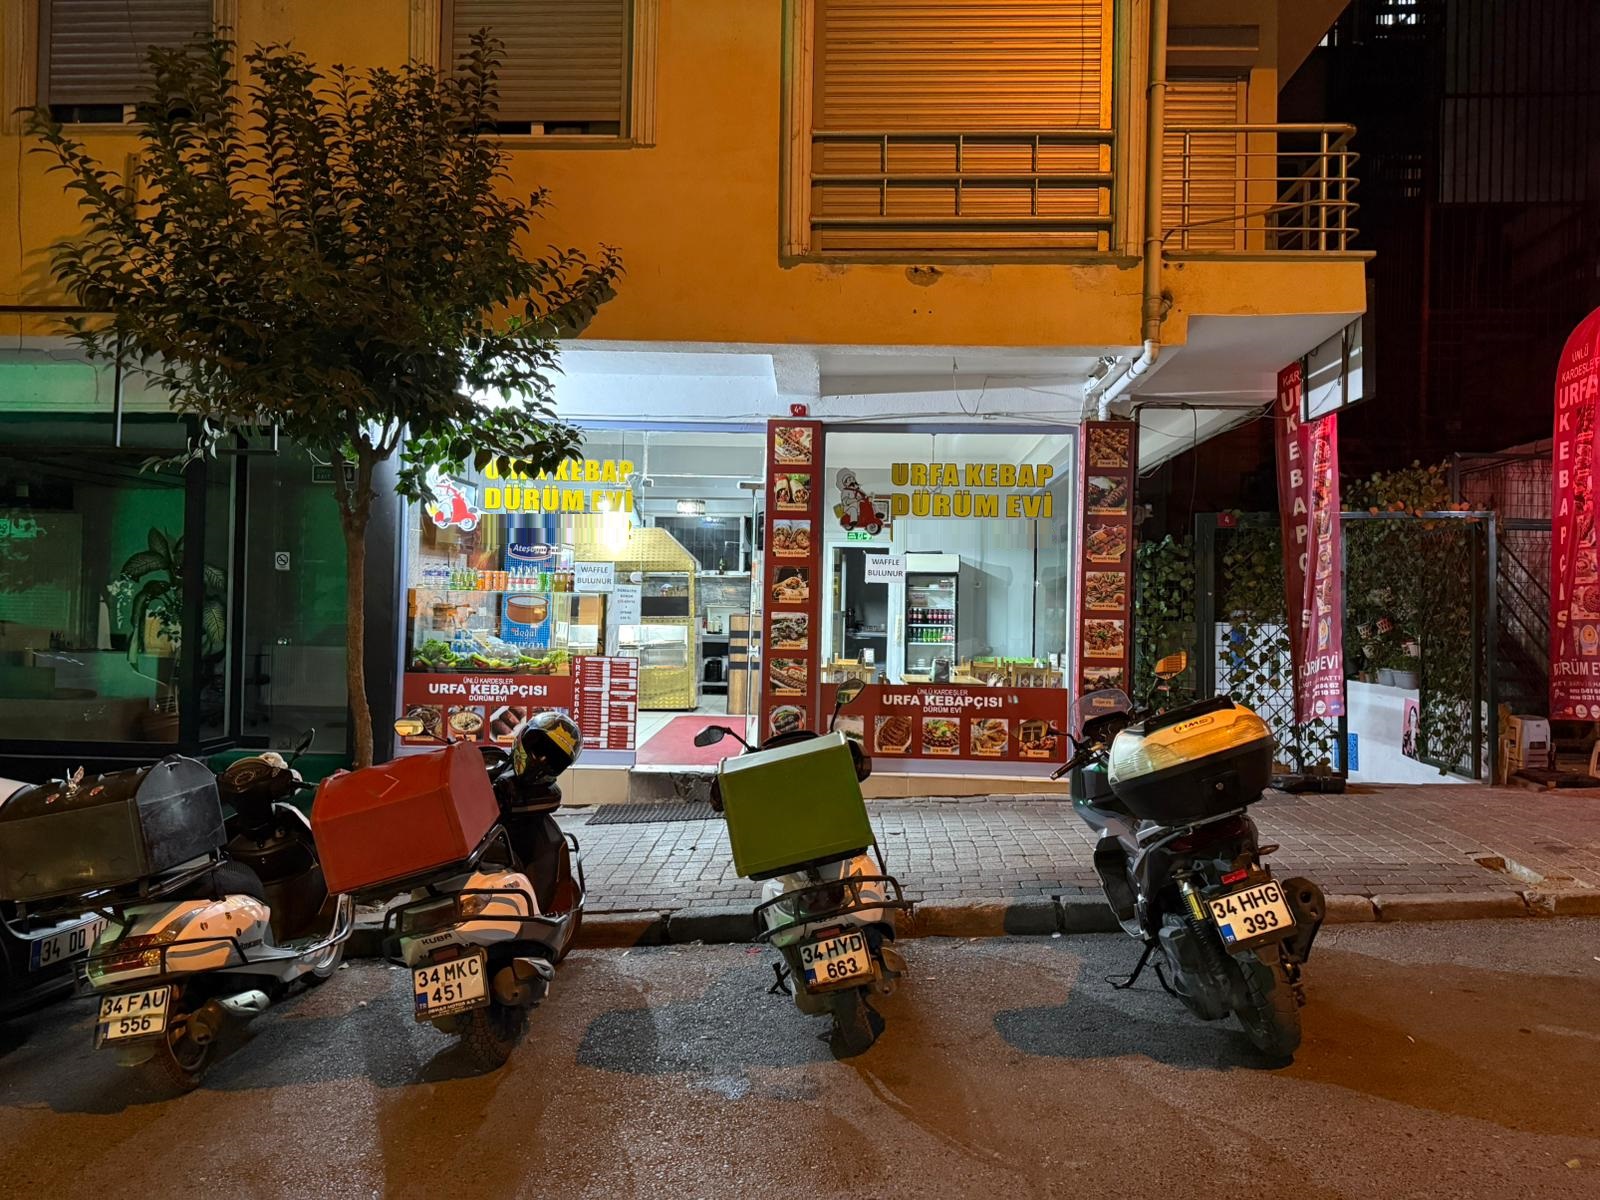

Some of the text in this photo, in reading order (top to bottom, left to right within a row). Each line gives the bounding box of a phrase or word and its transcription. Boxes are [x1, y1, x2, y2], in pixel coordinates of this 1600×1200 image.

[1282, 370, 1301, 387] KAR
[1559, 374, 1599, 409] URFA
[890, 462, 1055, 489] URFA KEBAP
[484, 483, 634, 513] DÜRÜM EVİ
[890, 489, 1054, 518] DÜRÜM EVİ
[580, 566, 609, 574] WAFFLE
[871, 558, 900, 566] WAFFLE
[576, 577, 612, 585] BULUNUR
[867, 569, 904, 577] BULUNUR
[428, 683, 548, 699] URFA KEBAPÇISI
[462, 676, 514, 686] ÜNLÜ KARDEŞLER
[468, 694, 508, 702] DÜRÜM EVİ
[882, 694, 1003, 710] URFA KEBAPÇISI
[917, 687, 969, 697] ÜNLÜ KARDEŞLER
[923, 705, 962, 714] DÜRÜM EVİ
[1212, 885, 1279, 919] 34 HHG
[1243, 910, 1279, 934] 393
[421, 932, 453, 945] KUBA
[42, 937, 60, 962] 34
[802, 935, 863, 963] 34 HYD
[417, 957, 479, 988] 34 MKC
[826, 957, 858, 979] 663
[103, 989, 166, 1016] 34 FAU
[431, 981, 463, 1004] 451
[119, 1015, 152, 1035] 556
